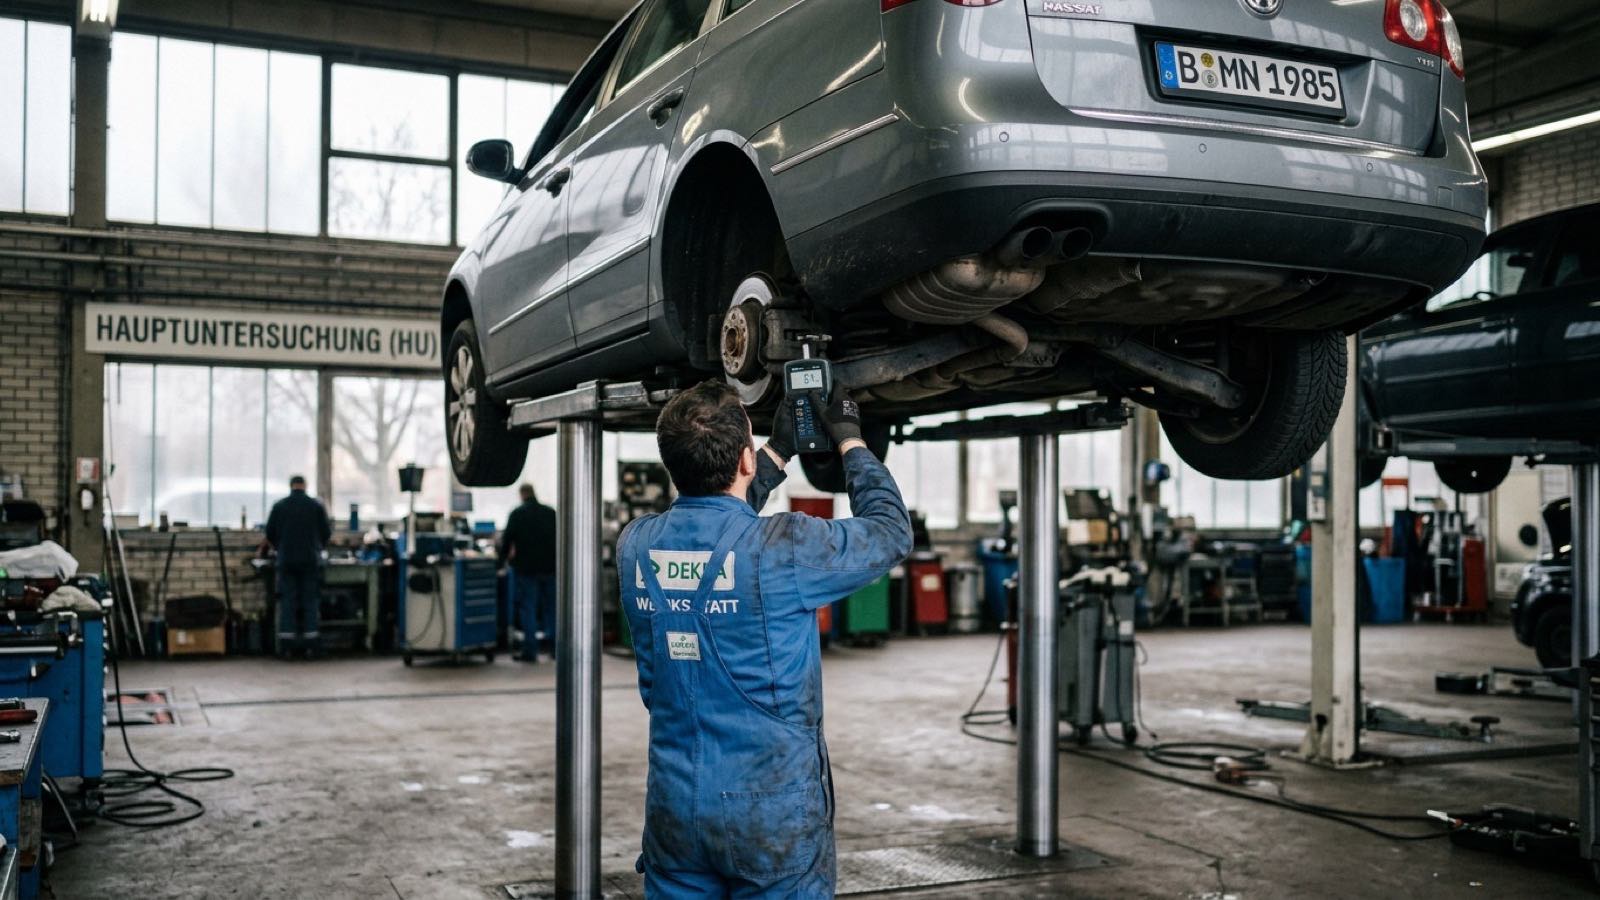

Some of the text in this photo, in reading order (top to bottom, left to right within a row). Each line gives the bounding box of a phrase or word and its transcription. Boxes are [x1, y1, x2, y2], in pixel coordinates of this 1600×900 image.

[1178, 51, 1336, 102] B MN 1985
[97, 314, 437, 360] HAUPTUNTERSUCHUNG (HU)
[668, 562, 726, 579] DEKA
